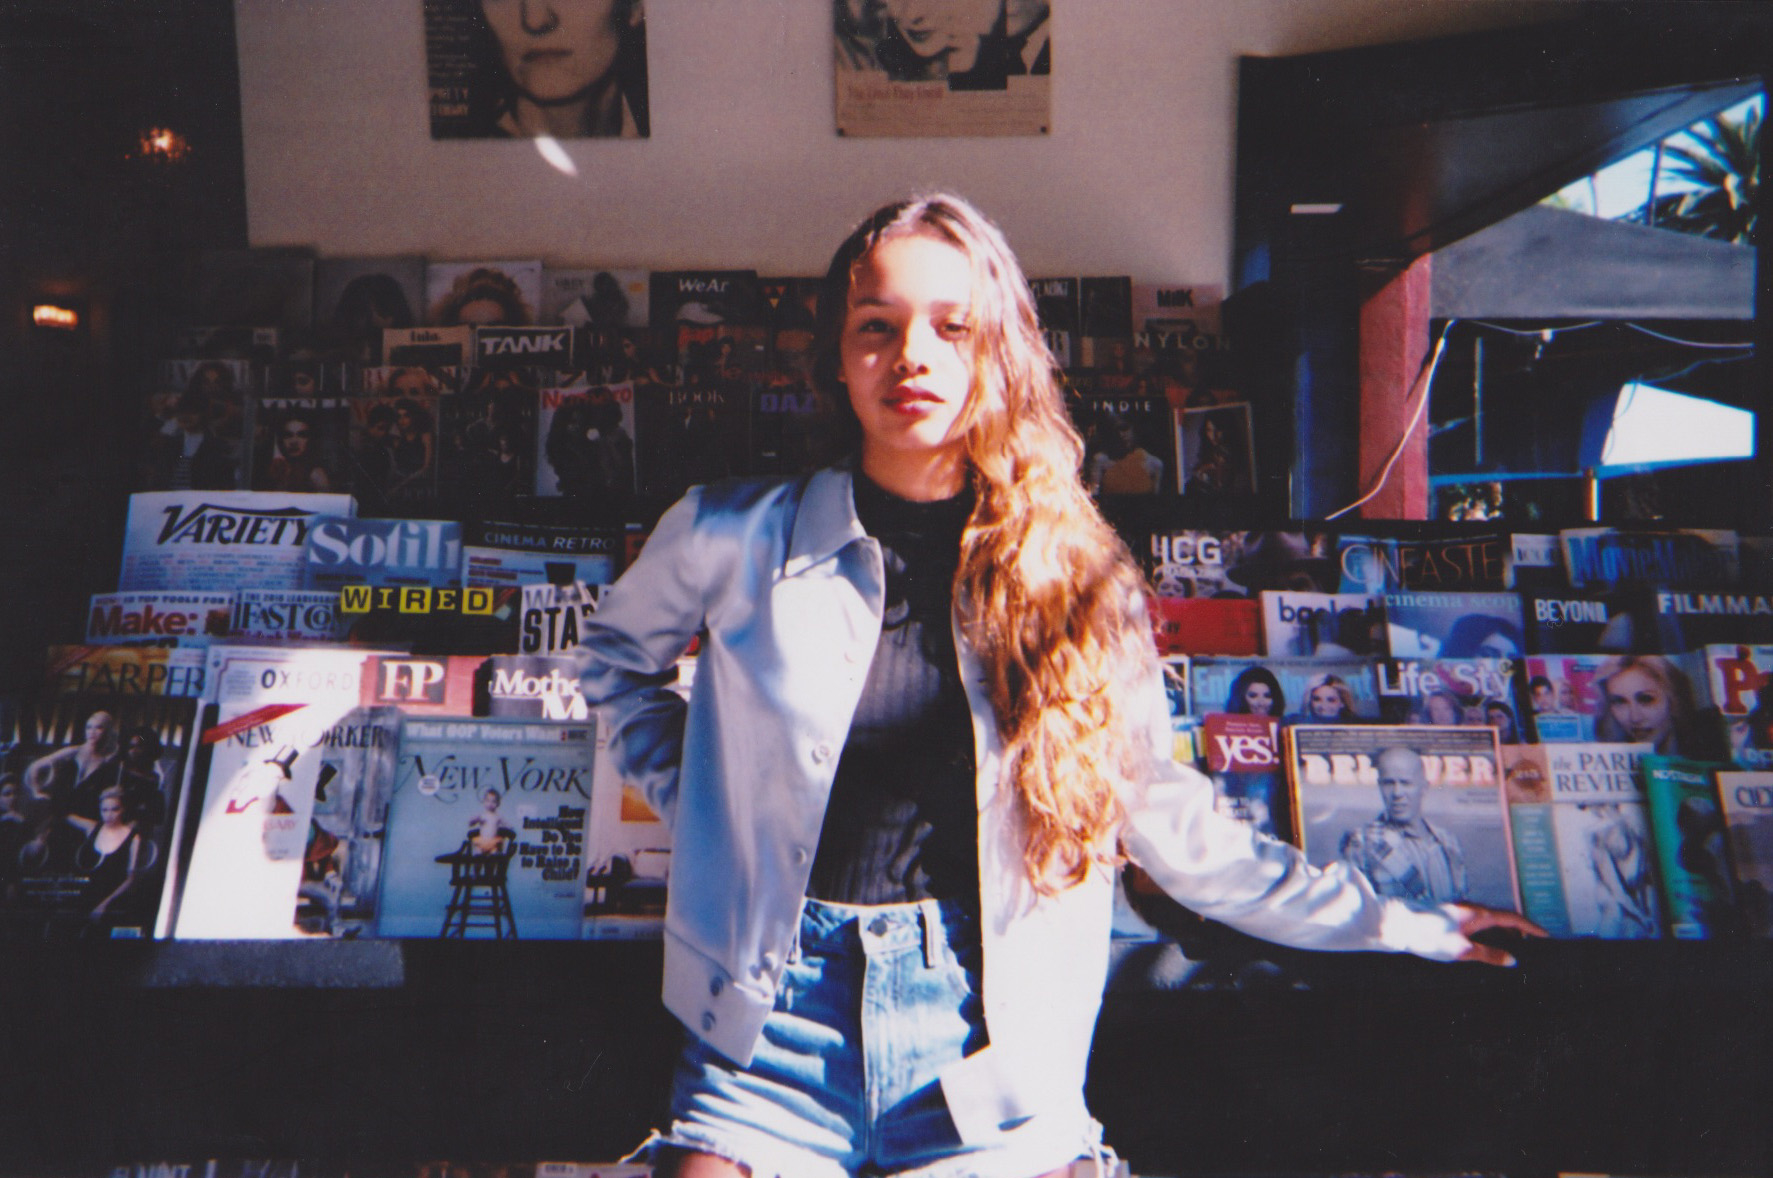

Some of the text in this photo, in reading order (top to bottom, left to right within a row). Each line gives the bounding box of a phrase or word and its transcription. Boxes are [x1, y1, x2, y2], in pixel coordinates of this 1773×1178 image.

[480, 333, 565, 356] TANK
[1134, 332, 1231, 350] NYLON
[1093, 400, 1152, 412] INDIE
[156, 503, 319, 546] VARIETY
[484, 532, 616, 550] CINEMA RETRO
[344, 587, 488, 613] WIRED
[1386, 593, 1519, 612] cinema scop
[90, 603, 198, 637] Make:
[260, 669, 354, 690] OXFORD
[379, 661, 445, 701] FP
[1378, 660, 1440, 696] Life
[1214, 721, 1280, 773] yes!
[520, 842, 548, 854] Have
[552, 844, 564, 855] to
[521, 856, 533, 867] to
